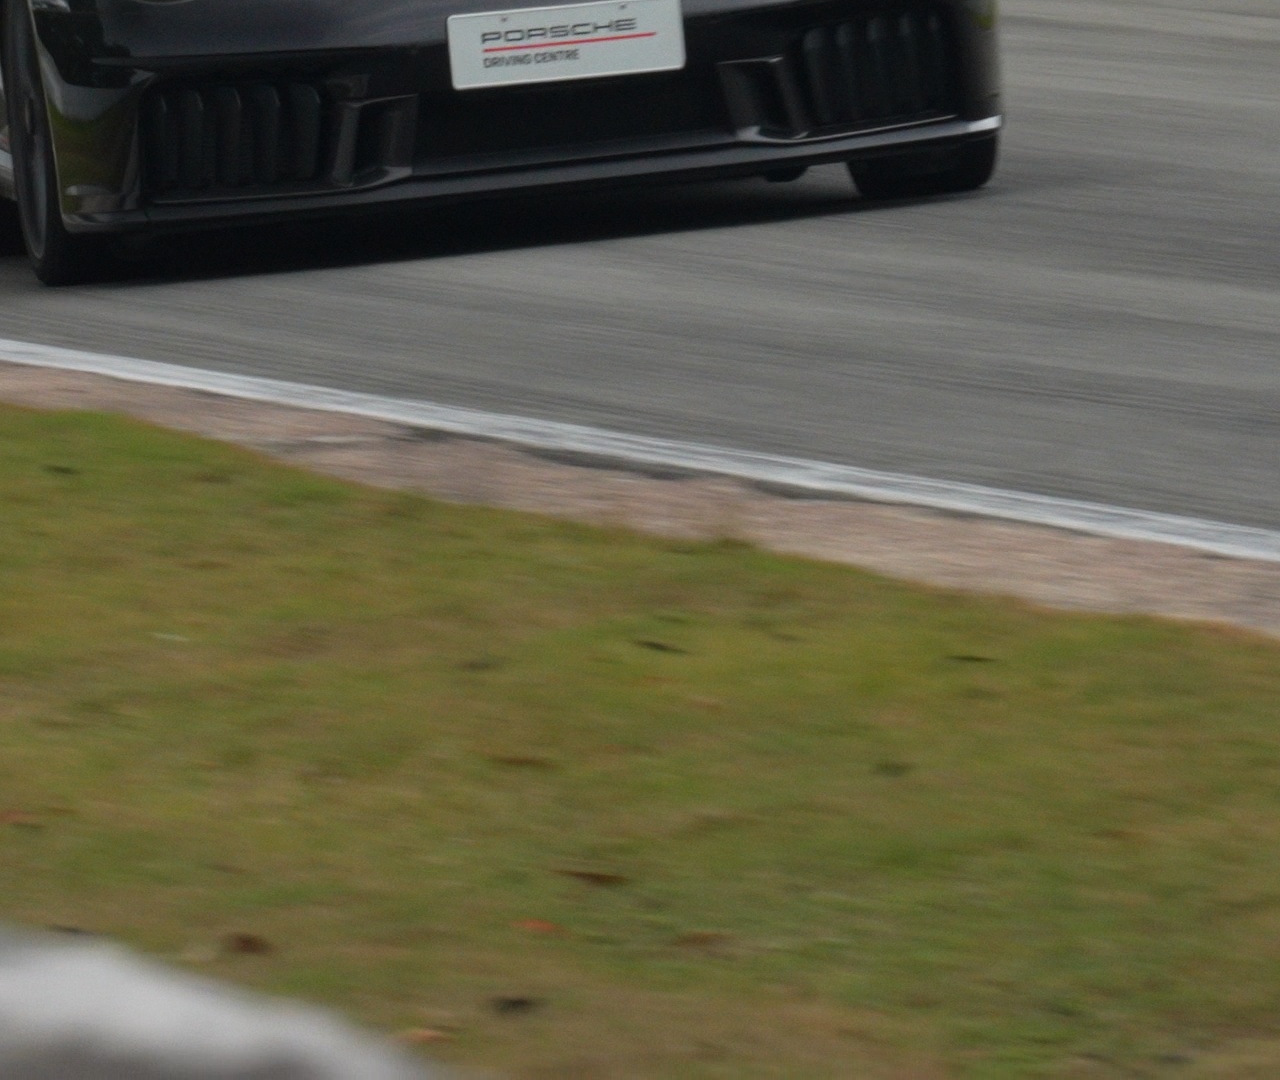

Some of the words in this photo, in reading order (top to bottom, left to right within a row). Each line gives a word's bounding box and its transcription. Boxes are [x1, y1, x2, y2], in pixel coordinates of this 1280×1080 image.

[481, 17, 637, 44] PORSCHE
[483, 53, 532, 68] DRIVING
[534, 48, 580, 64] CENTRE
